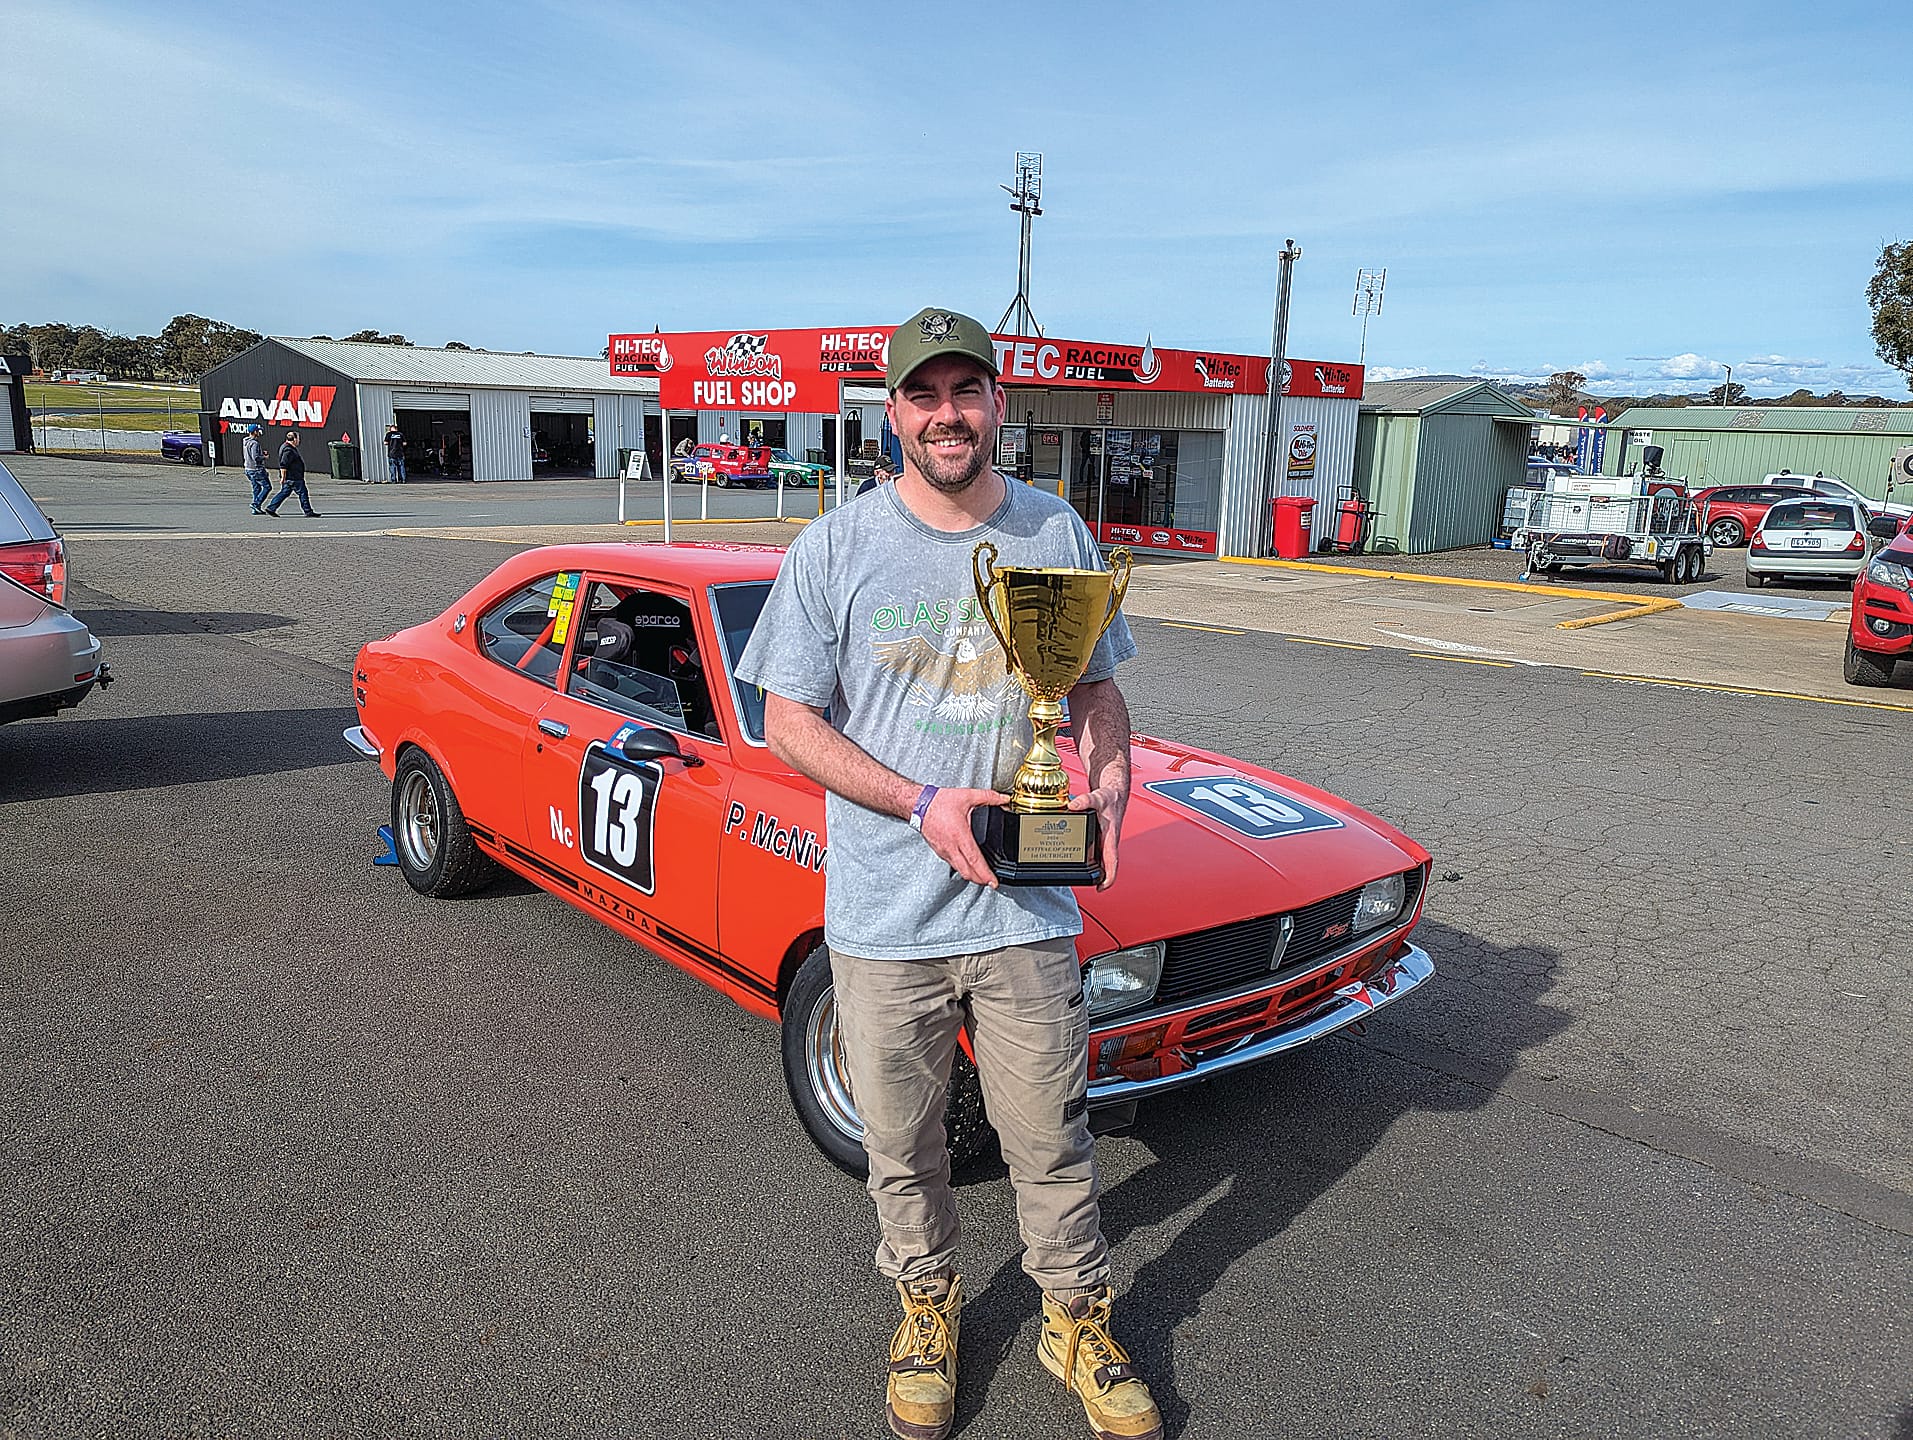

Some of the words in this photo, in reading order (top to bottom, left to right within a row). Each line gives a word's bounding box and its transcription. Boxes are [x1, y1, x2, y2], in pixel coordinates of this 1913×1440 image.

[614, 339, 660, 354] HI-TEC
[820, 332, 883, 351] HI-TEC
[615, 354, 659, 362] RACING
[820, 352, 880, 361] RACING
[1066, 349, 1139, 367] RACING
[821, 363, 852, 372] FUEL
[1064, 366, 1105, 380] FUEL
[693, 381, 736, 405] FUEL
[741, 380, 796, 406] SHOP
[219, 398, 322, 423] ADVAN
[943, 625, 987, 638] COMPANY
[1188, 783, 1305, 827] 13
[590, 767, 643, 867] 13
[549, 805, 574, 849] Nc
[724, 800, 747, 841] P.
[750, 810, 828, 875] McNiv
[583, 885, 650, 930] MAZDA
